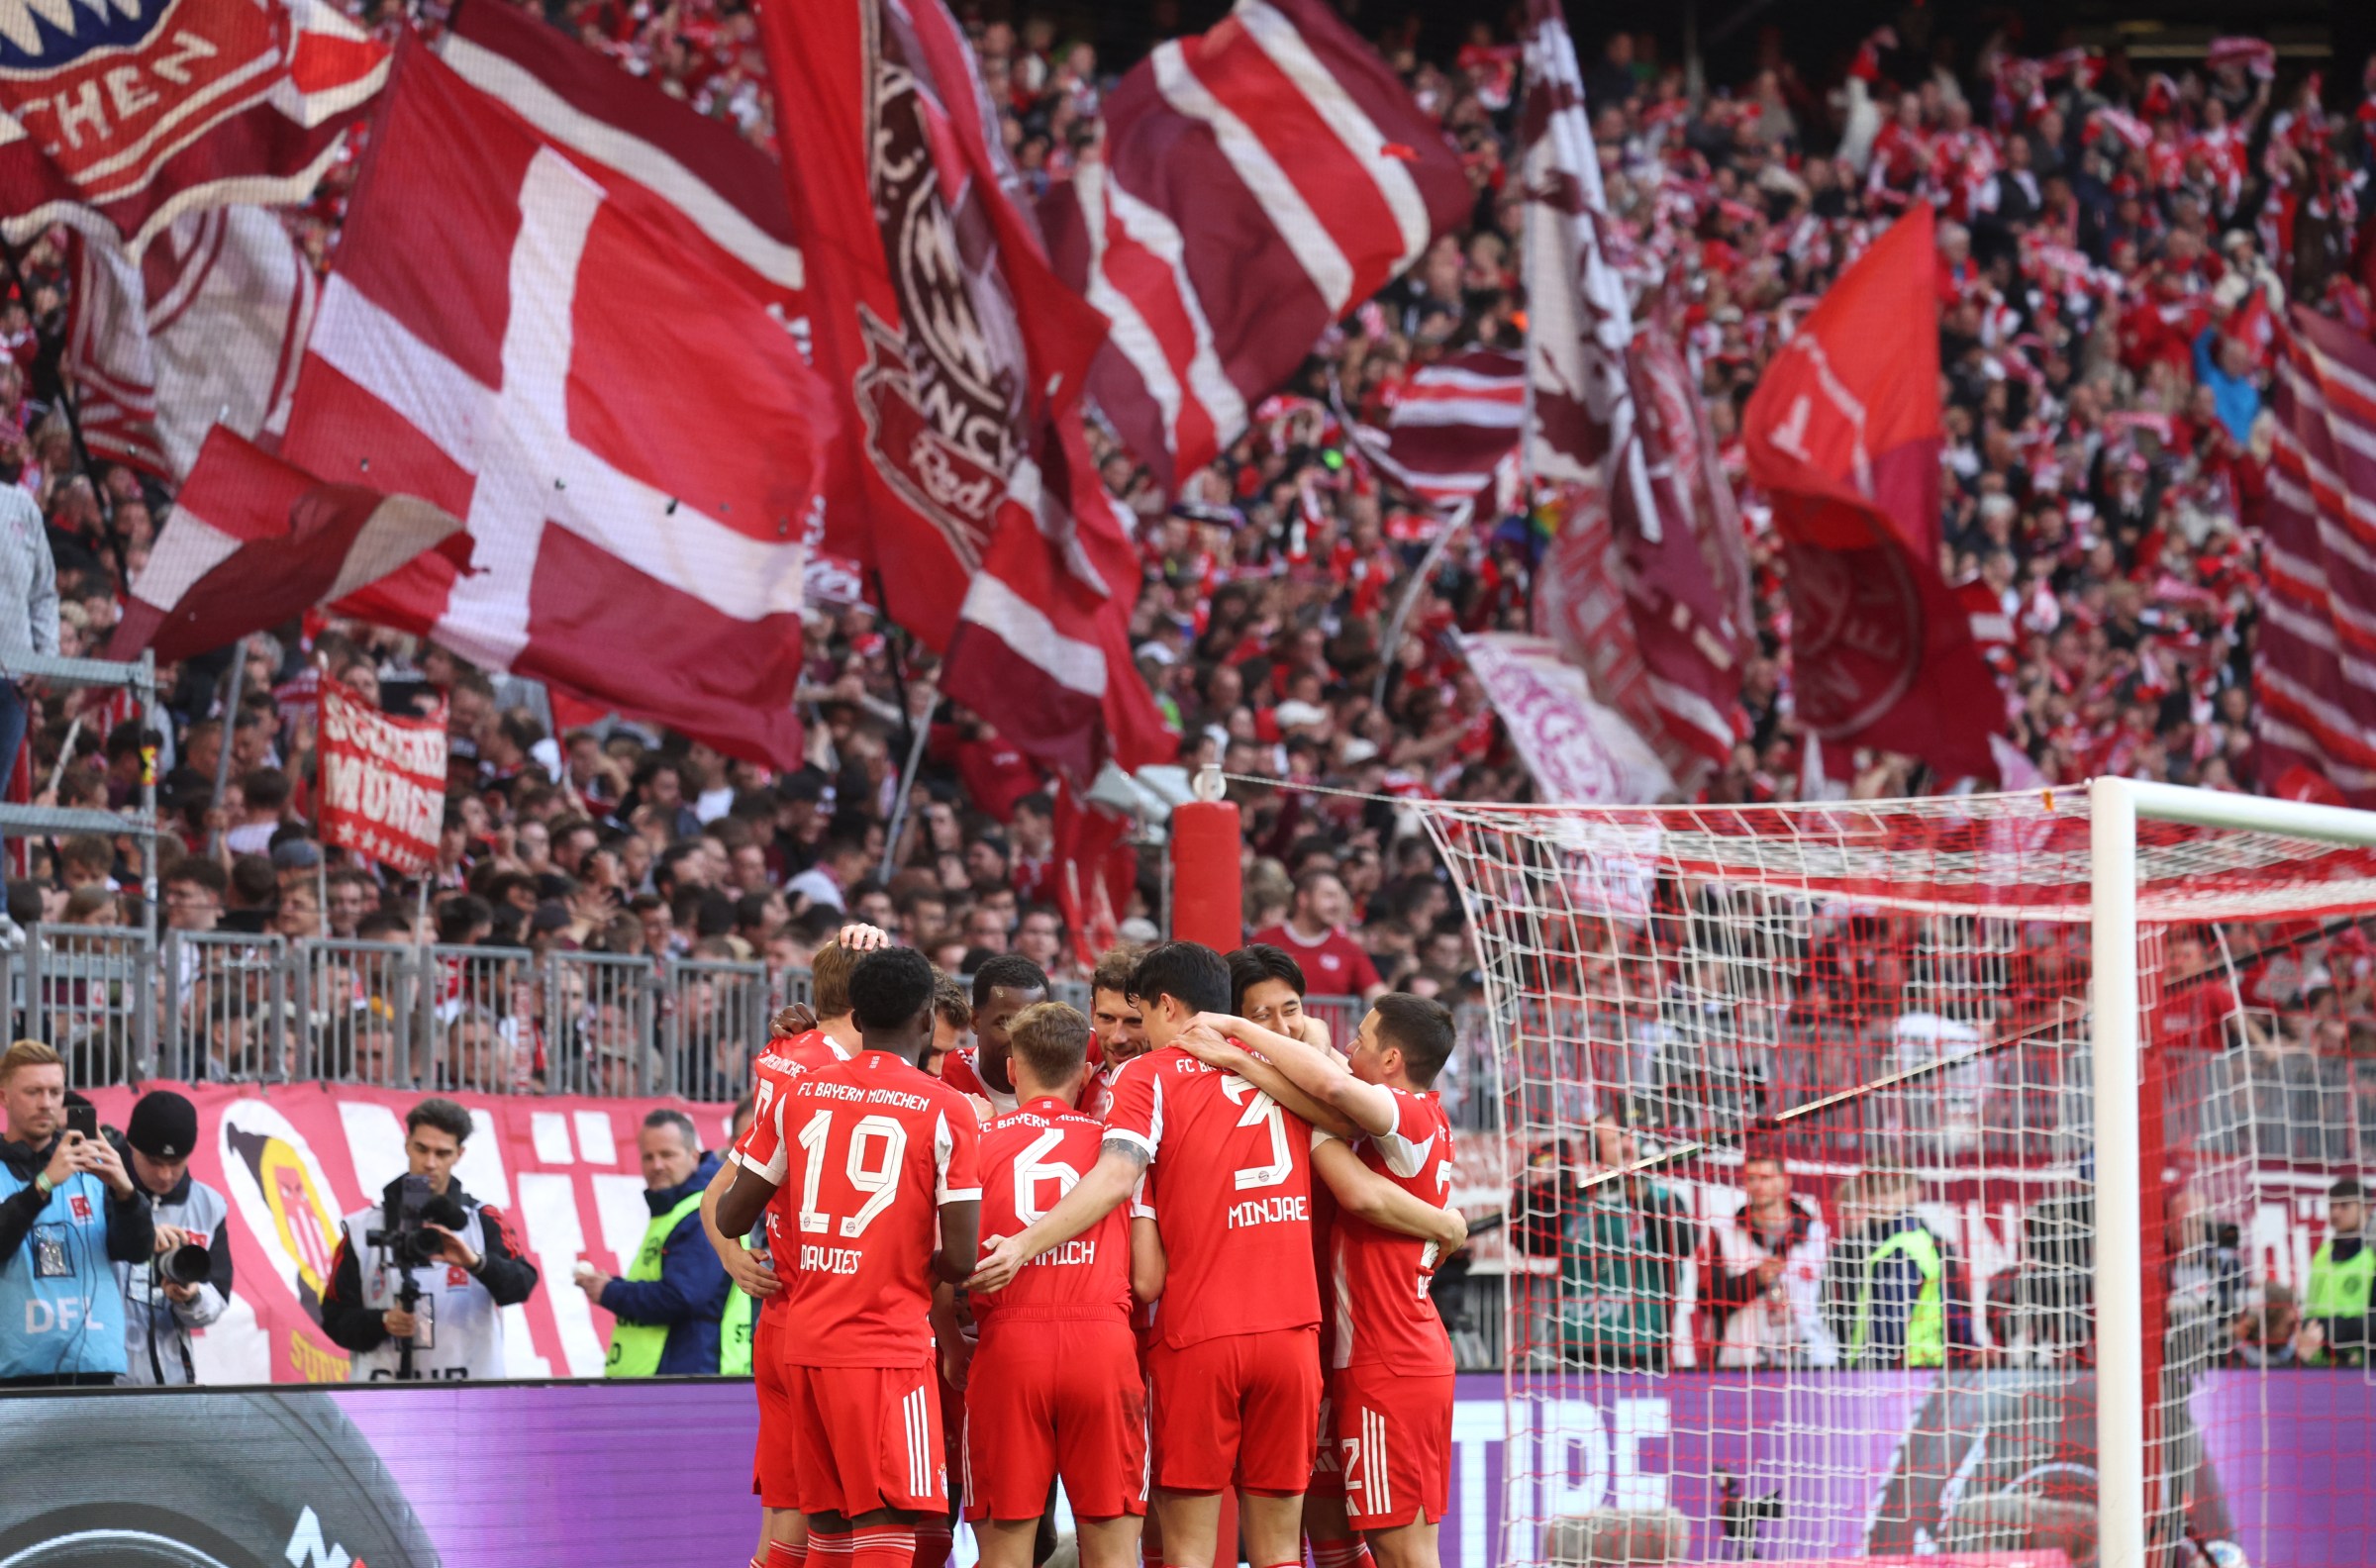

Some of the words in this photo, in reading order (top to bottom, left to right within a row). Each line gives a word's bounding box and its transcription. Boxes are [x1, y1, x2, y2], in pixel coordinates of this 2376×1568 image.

[1176, 1058, 1195, 1073] FC
[797, 1082, 813, 1096] FC
[814, 1081, 866, 1102] BAYERN
[866, 1089, 931, 1113] MÜNCHEN
[997, 1113, 1050, 1129] BAYERN
[1221, 1074, 1293, 1191] 3
[797, 1109, 908, 1238] 19
[1014, 1127, 1080, 1227] 6
[1228, 1196, 1310, 1229] MINJAE
[799, 1243, 862, 1275] DAVIES
[1023, 1240, 1095, 1267] MICH
[25, 1296, 105, 1334] DFL
